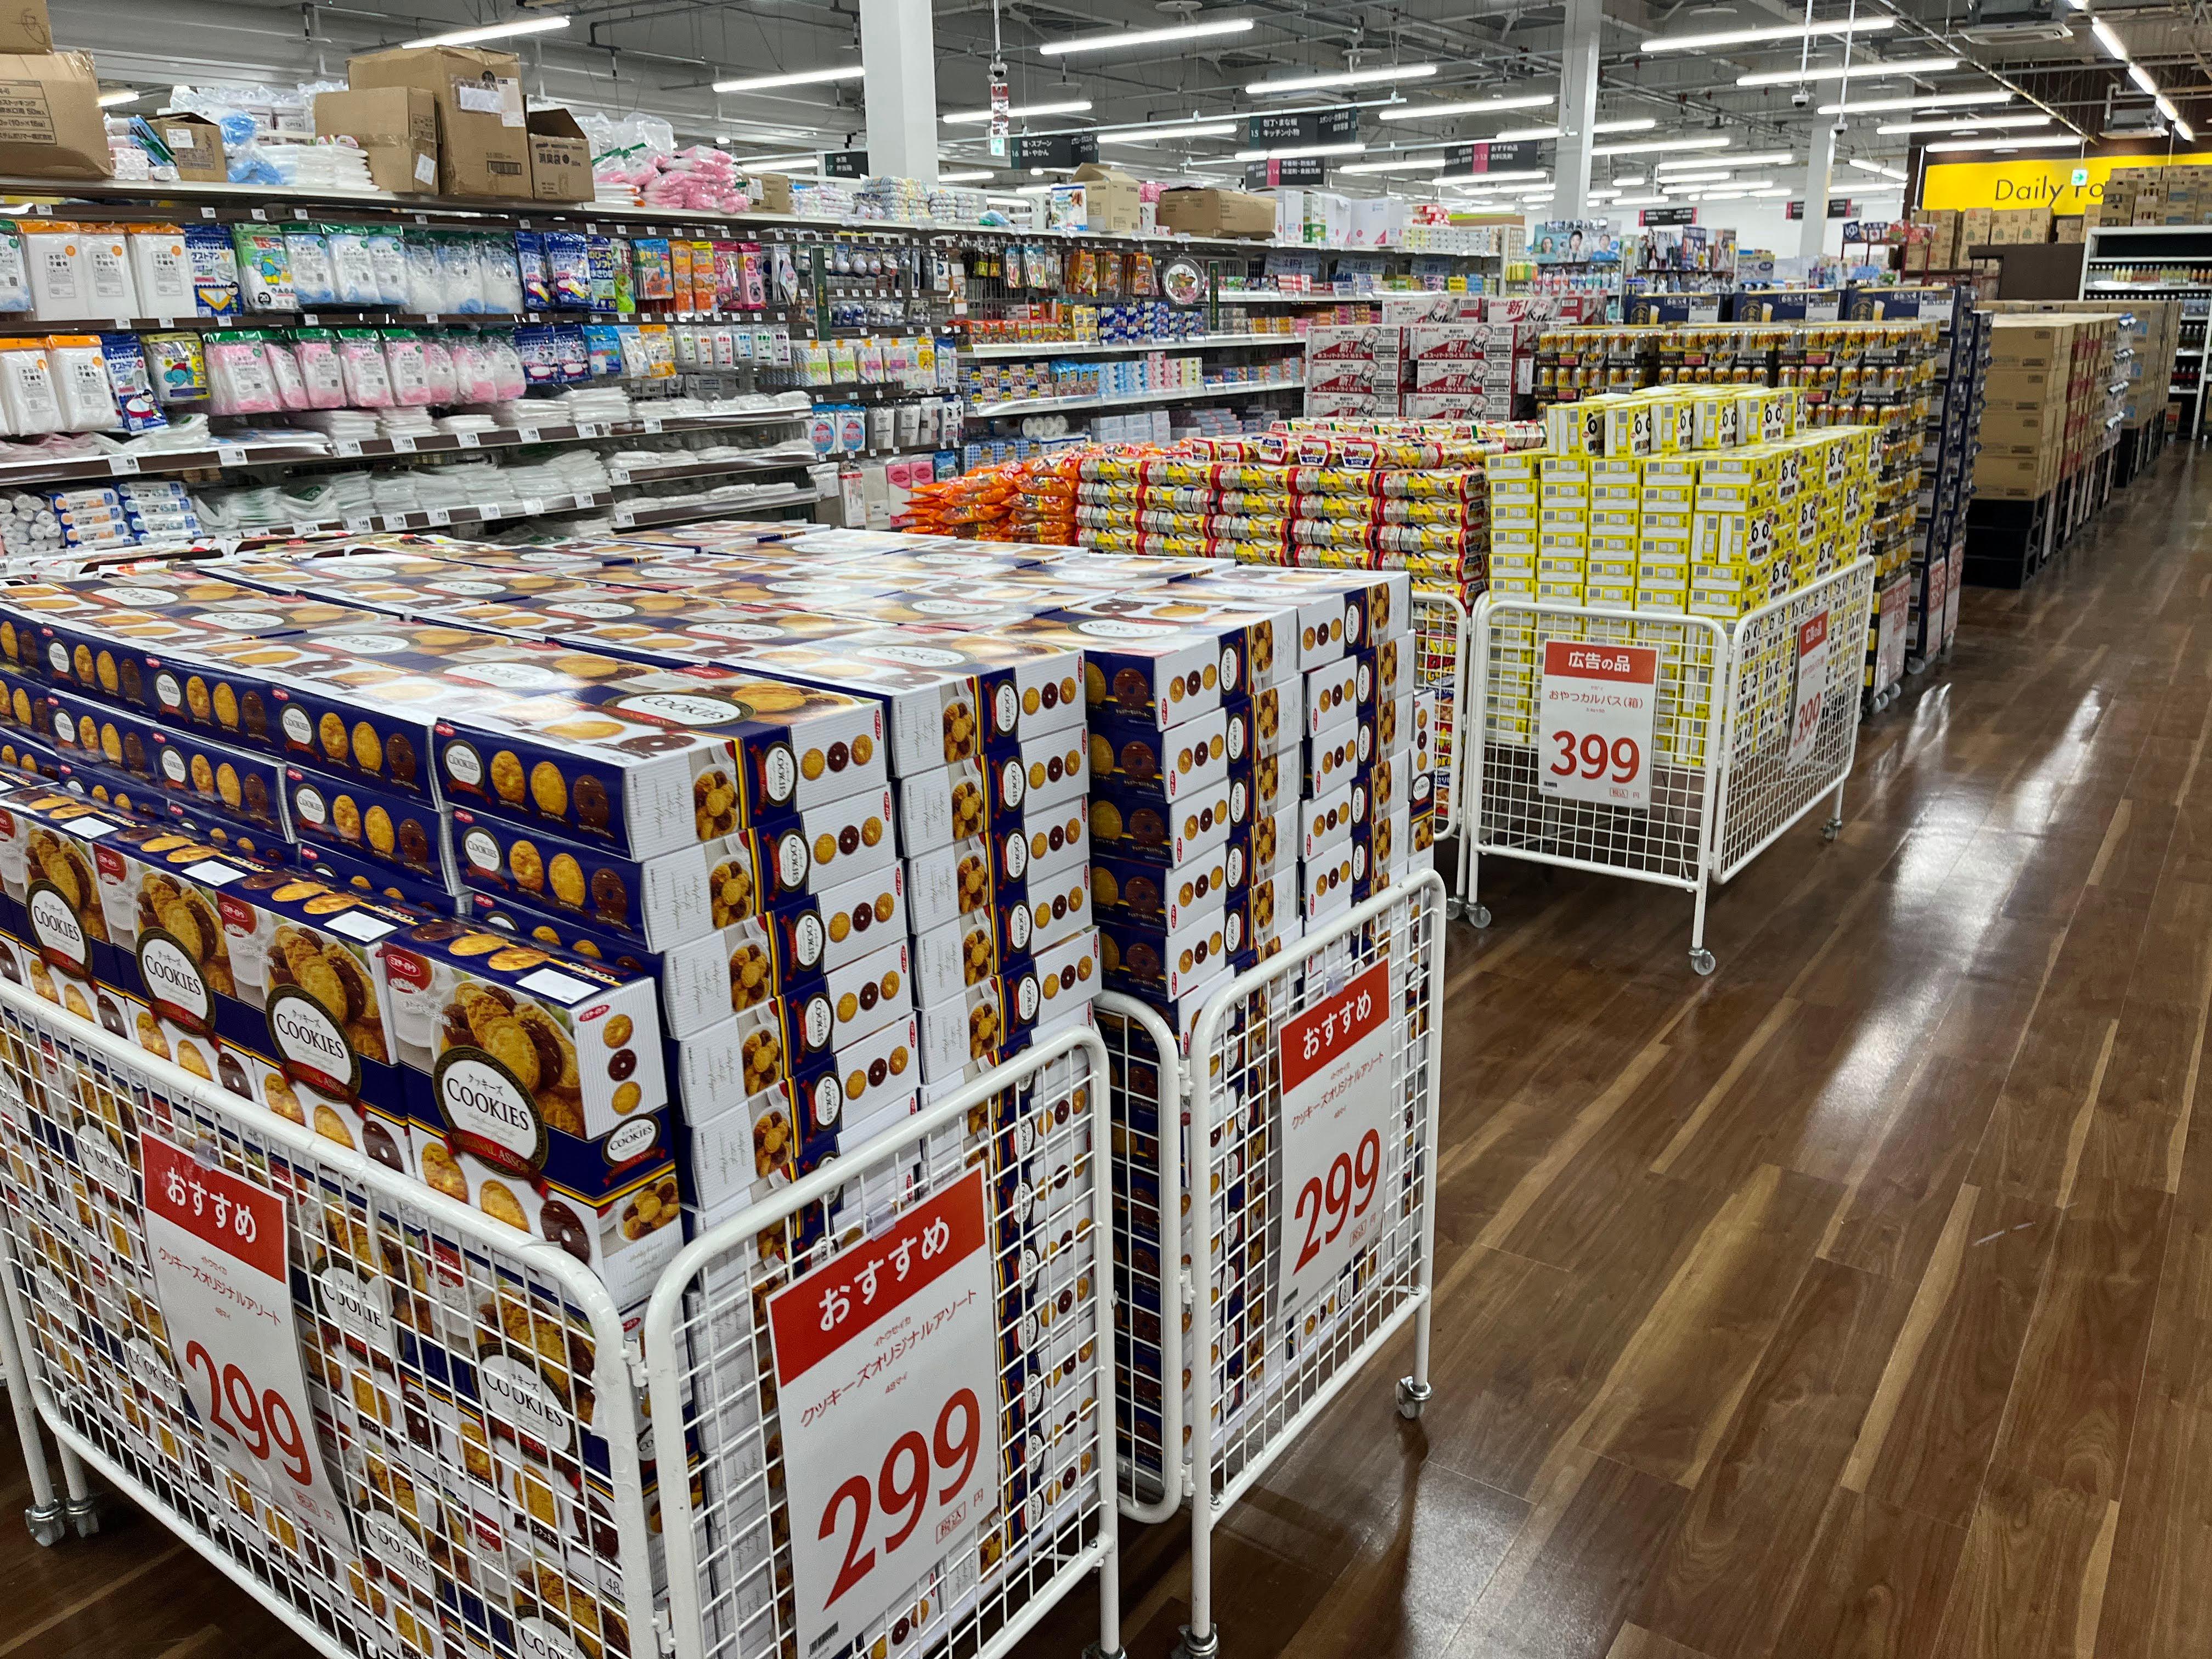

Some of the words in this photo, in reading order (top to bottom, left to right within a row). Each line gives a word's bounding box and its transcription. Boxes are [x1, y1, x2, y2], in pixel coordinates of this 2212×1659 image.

[1263, 128, 1300, 137] キッチン小物
[1995, 175, 2065, 207] Daily
[1567, 650, 1631, 674] 広告の品
[641, 695, 731, 721] COOKIES
[1550, 730, 1640, 785] 399
[790, 836, 800, 883] COOKIES
[33, 904, 80, 942] COOKIES
[805, 917, 815, 962] COOKIES
[145, 954, 200, 996] COOKIES
[276, 1014, 344, 1060] COOKIES
[814, 998, 824, 1044] COOKIES
[1302, 989, 1373, 1062] おすすめ
[447, 1077, 529, 1131] COOKIES
[468, 1073, 504, 1097] クッキーズ
[823, 1077, 834, 1122] COOKIES
[1291, 1050, 1386, 1131] クッキーズオリジナルアソート
[609, 1123, 656, 1154] COOKIES
[166, 1167, 257, 1244] おすすめ
[1293, 1127, 1380, 1277] 299
[159, 1246, 281, 1326] クッキーズオリジナルアソート
[819, 1216, 950, 1333] おすすめ
[873, 1316, 912, 1347] イトウセイカ
[800, 1288, 978, 1428] クッキーズオリジナルアソート
[186, 1340, 313, 1486] 299
[817, 1388, 981, 1611] 299
[939, 1506, 963, 1538] 税込
[972, 1488, 984, 1508] 円
